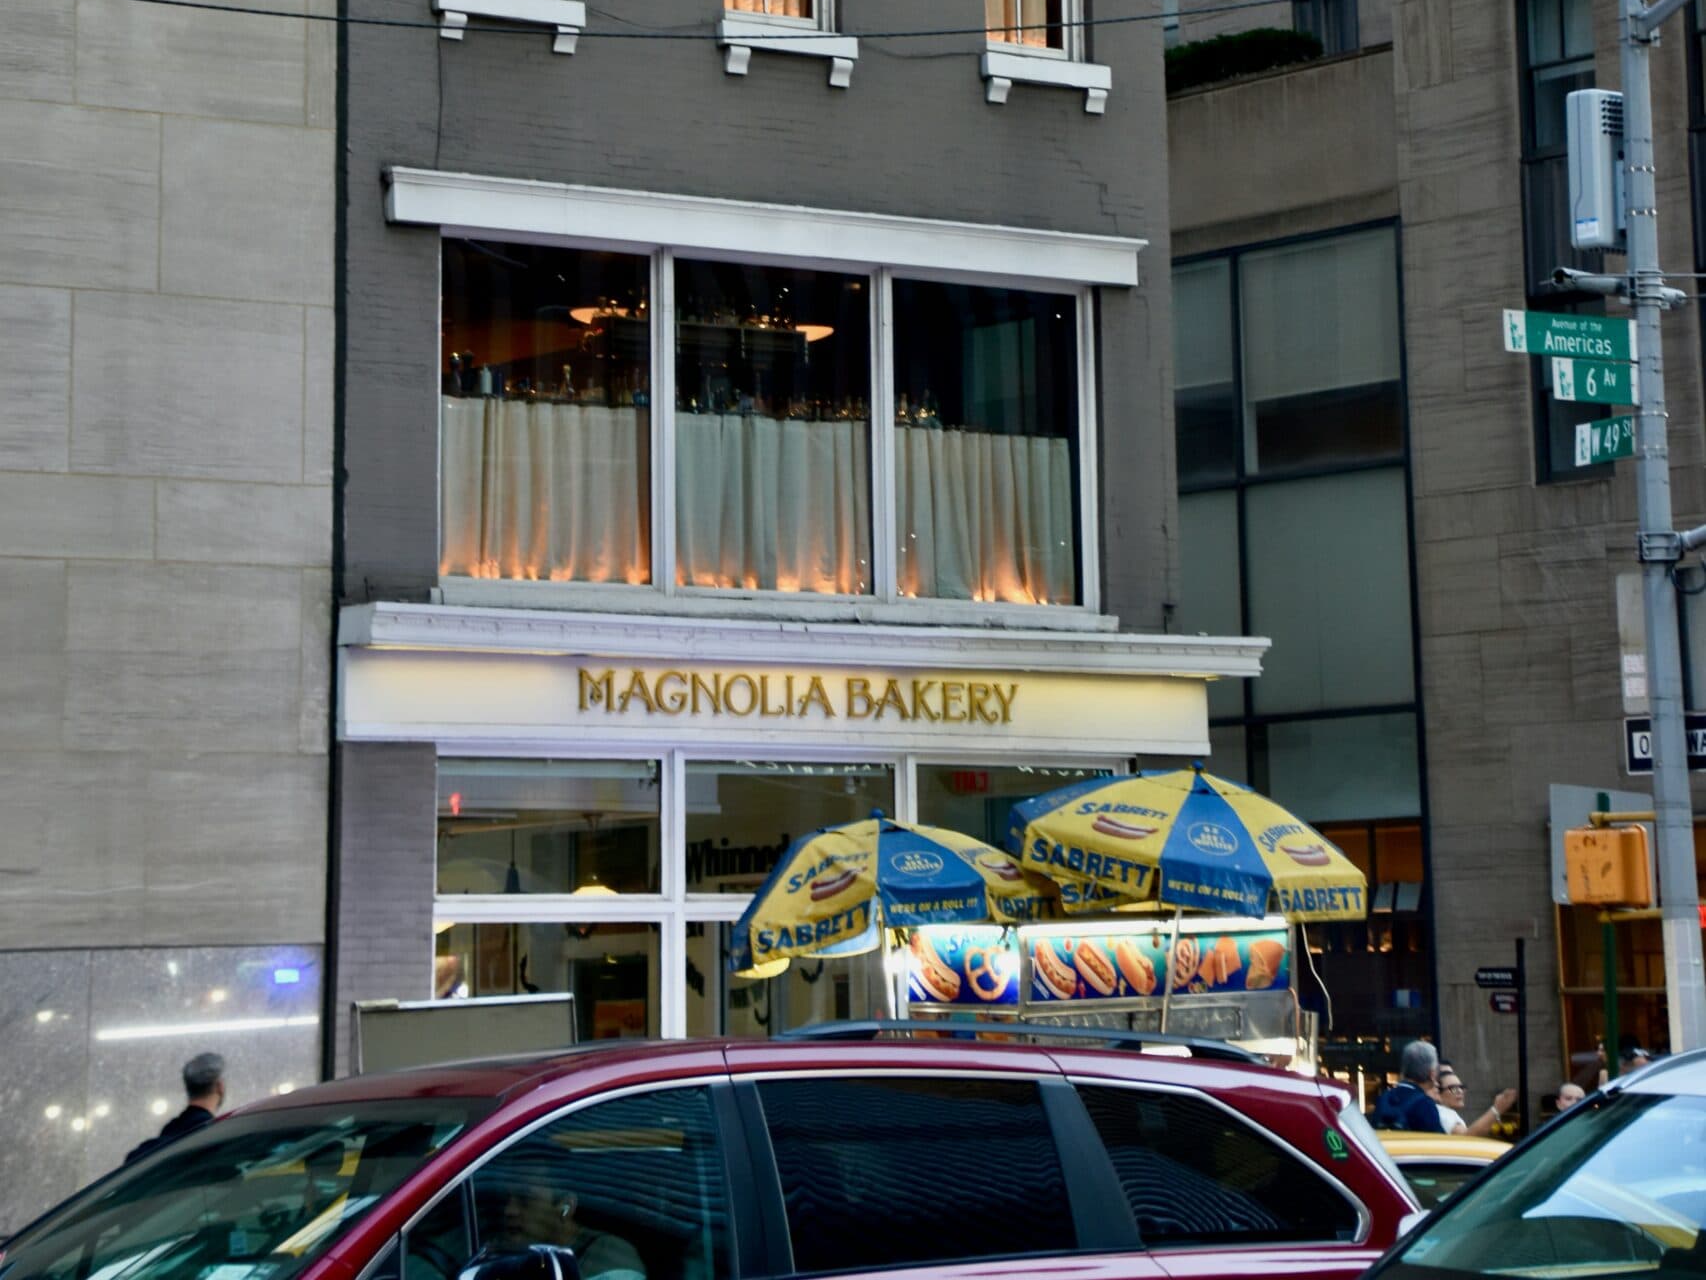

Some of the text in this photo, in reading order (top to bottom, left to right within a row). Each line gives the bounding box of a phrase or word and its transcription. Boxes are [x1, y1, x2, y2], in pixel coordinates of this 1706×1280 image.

[1551, 319, 1603, 332] Avenue of the
[1544, 331, 1613, 355] Americas
[1586, 367, 1617, 397] 6 Av
[1591, 427, 1601, 456] W
[1604, 423, 1620, 454] 49
[576, 667, 1020, 724] MAGNOLIA BAKERY
[1075, 801, 1169, 820] SABRETT
[1257, 824, 1305, 854] SABRETT
[786, 851, 871, 894] SABRETT
[1030, 838, 1151, 888] SABRETT
[1280, 886, 1361, 912] SABRETT
[757, 899, 872, 954] SABRETT
